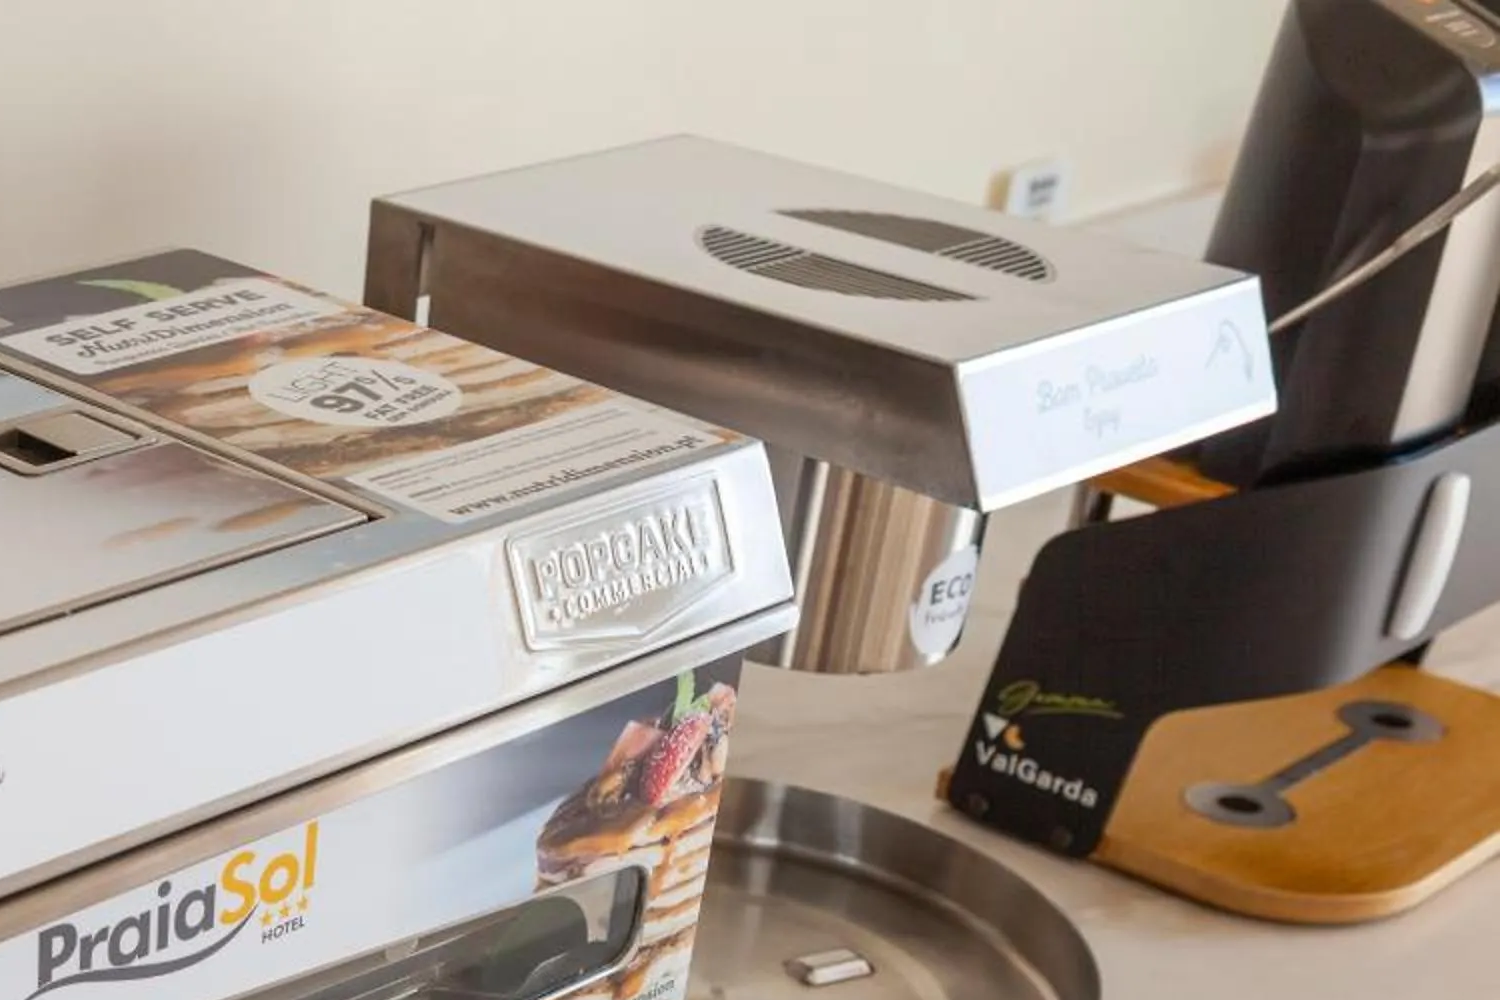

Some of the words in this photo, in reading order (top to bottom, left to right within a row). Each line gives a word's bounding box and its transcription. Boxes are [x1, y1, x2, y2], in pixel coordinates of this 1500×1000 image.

[46, 318, 137, 347] SELF
[145, 289, 268, 323] SERVE
[309, 369, 417, 413] 97%
[450, 434, 705, 516] www.nutridimension.pt
[976, 740, 1099, 809] ValGarda
[38, 818, 319, 988] PraiaSol
[261, 914, 306, 944] HOTEL
